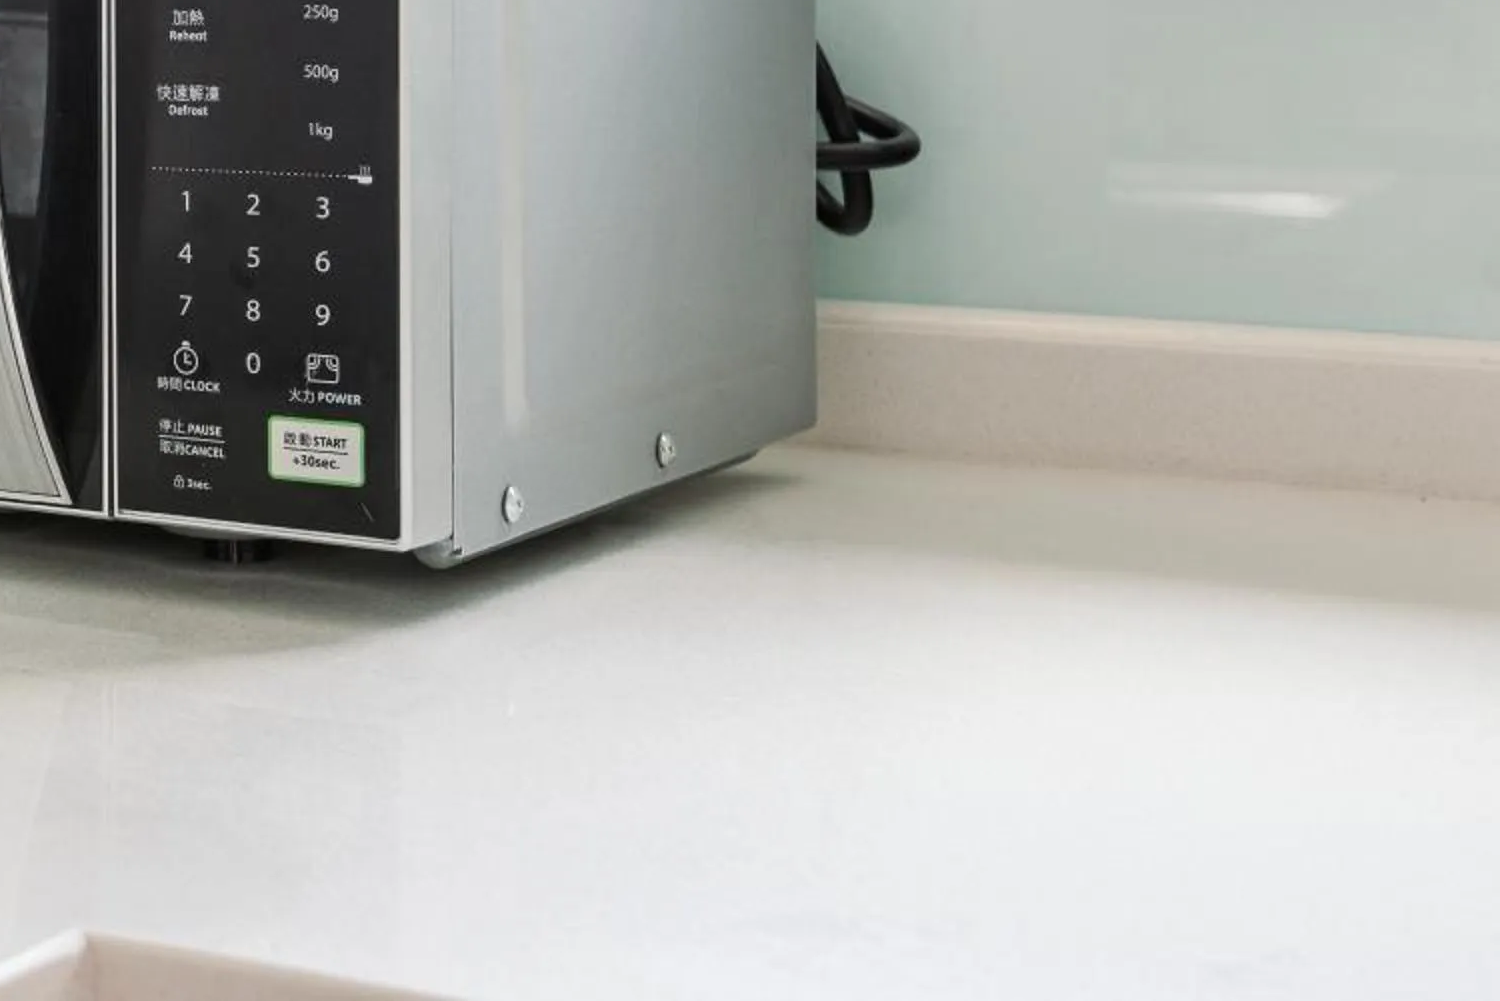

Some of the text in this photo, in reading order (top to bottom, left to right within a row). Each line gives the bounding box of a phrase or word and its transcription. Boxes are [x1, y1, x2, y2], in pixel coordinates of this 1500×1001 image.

[303, 4, 338, 21] 250g
[170, 31, 207, 42] Reheat
[303, 64, 338, 83] 500g
[168, 105, 208, 116] Defrost
[308, 123, 332, 140] 1kg
[182, 191, 191, 211] 1
[246, 194, 260, 215] 2
[316, 197, 330, 219] 3
[178, 243, 192, 263] 4
[247, 247, 260, 267] 5
[316, 251, 330, 272] 6
[180, 295, 192, 316] 7
[246, 300, 260, 321] 8
[316, 305, 330, 326] 9
[246, 353, 260, 374] 0
[184, 380, 220, 393] CLOCK
[288, 387, 362, 405] 火力 POWER
[188, 423, 223, 437] PAUSE
[313, 435, 348, 449] START
[185, 445, 226, 458] CANCEL
[293, 455, 340, 469] +30sec.
[188, 479, 212, 490] 3sec.
